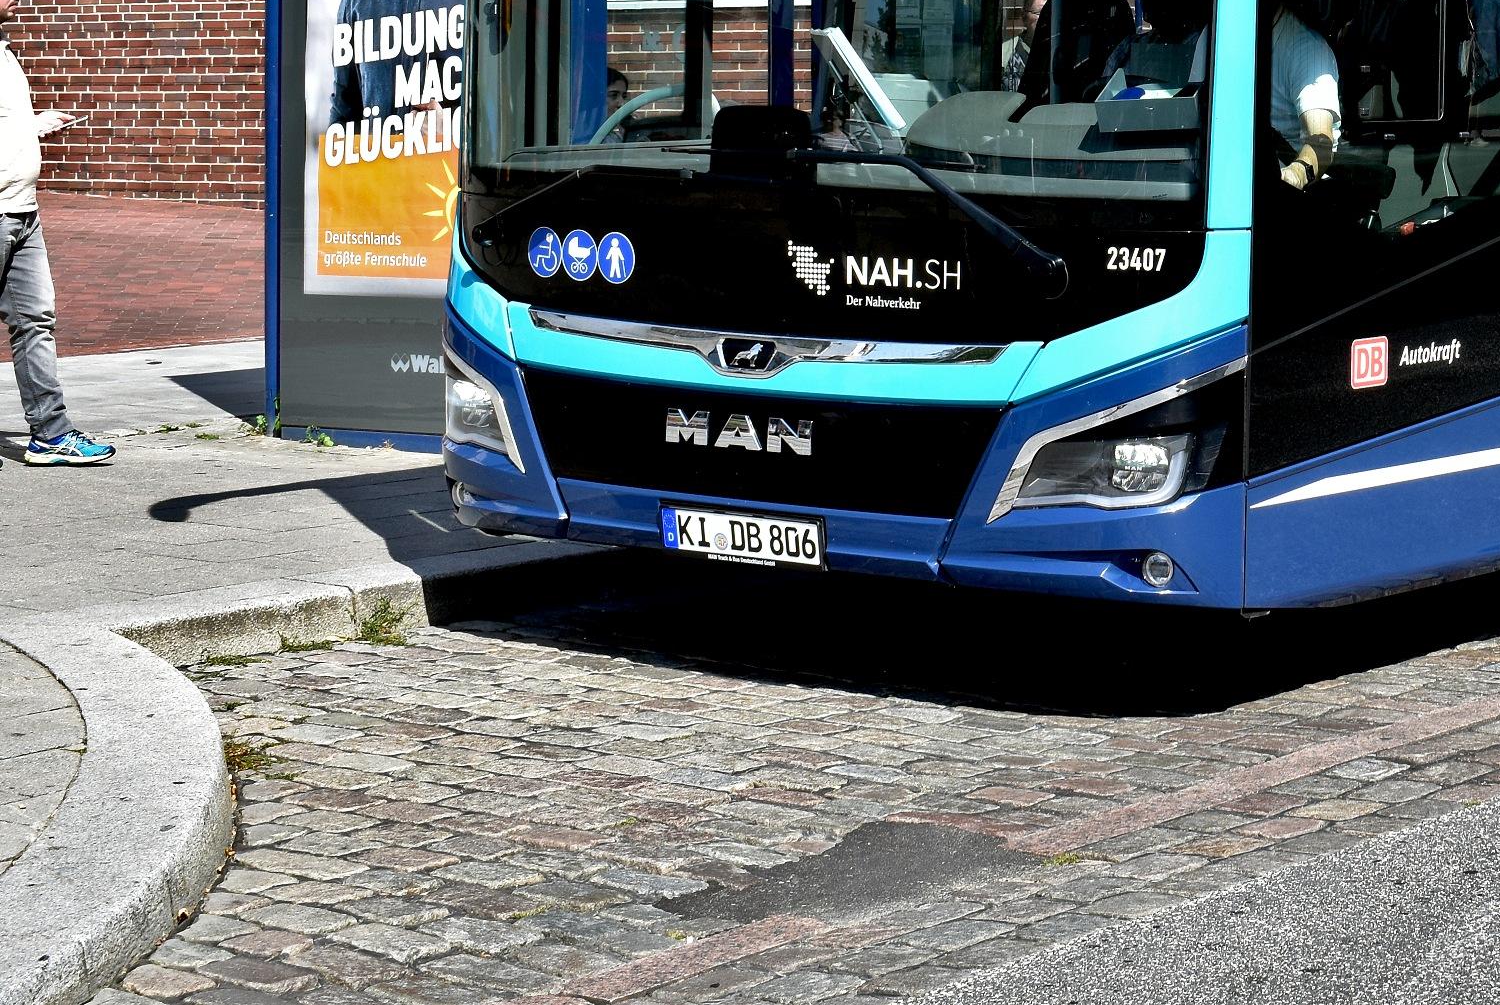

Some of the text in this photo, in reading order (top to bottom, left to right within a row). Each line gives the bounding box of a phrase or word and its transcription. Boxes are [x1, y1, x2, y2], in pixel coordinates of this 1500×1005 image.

[333, 4, 465, 67] BILDUNG
[395, 55, 463, 109] MAC
[324, 230, 402, 246] Deutschlands
[323, 250, 428, 268] größte Fernschule
[846, 255, 961, 290] NAH.SH
[1106, 246, 1167, 272] 23407
[846, 295, 922, 310] Der Nahverkehr
[1355, 338, 1462, 380] DB Autokraft
[664, 407, 814, 456] MAN
[667, 532, 675, 542] D
[677, 514, 817, 559] KI DB 806
